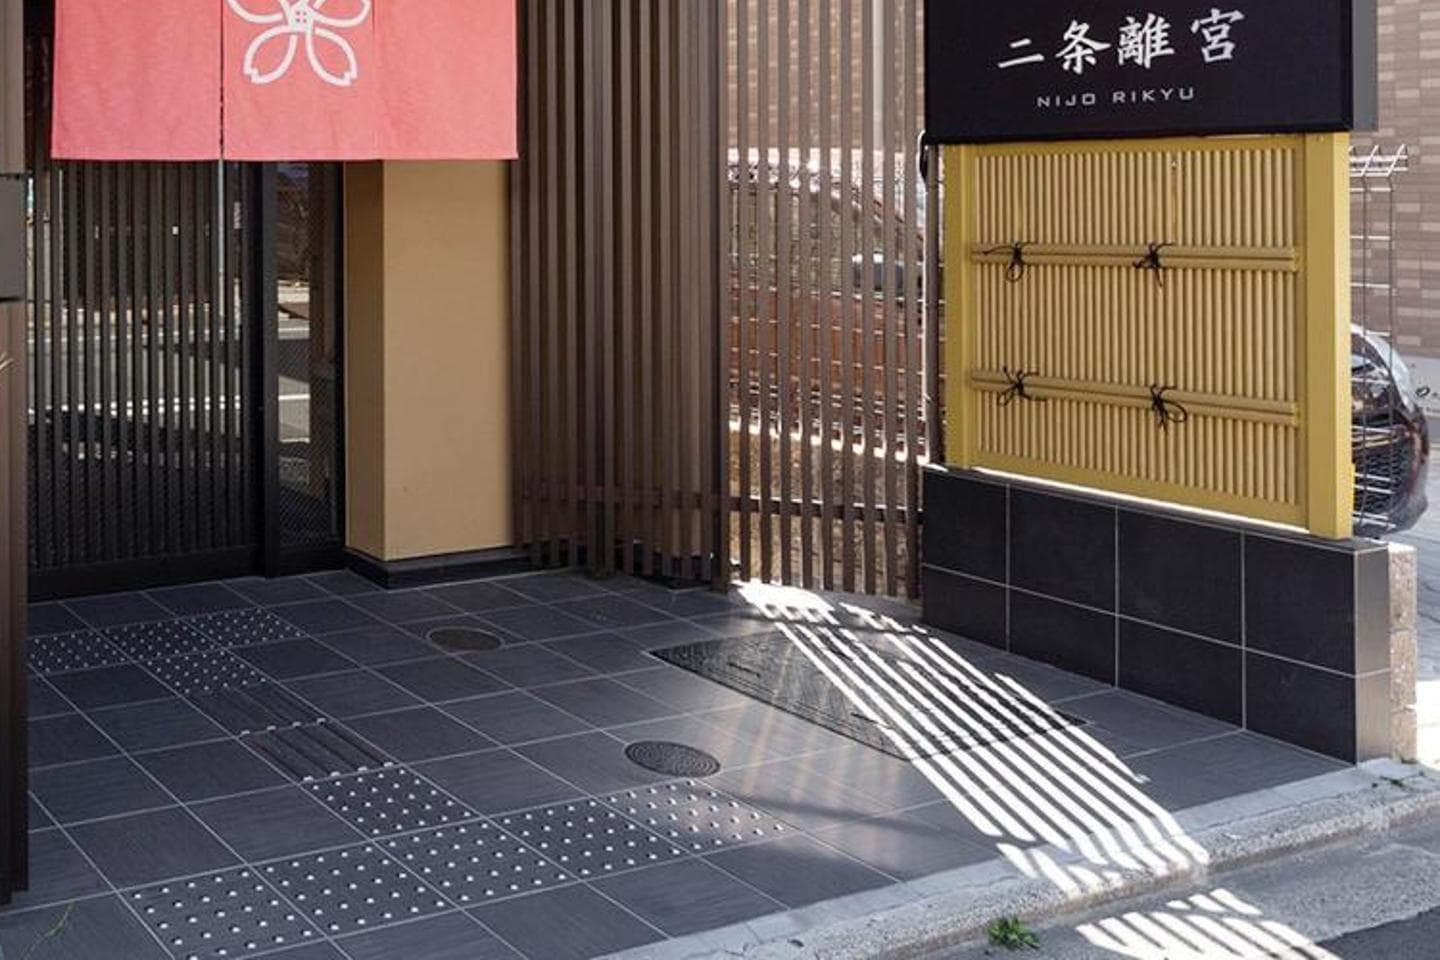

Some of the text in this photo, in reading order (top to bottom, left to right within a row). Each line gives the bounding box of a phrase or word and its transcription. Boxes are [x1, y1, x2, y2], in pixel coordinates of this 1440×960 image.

[998, 8, 1245, 74] 二条離宮
[1037, 87, 1195, 109] NIJO RIKYU
